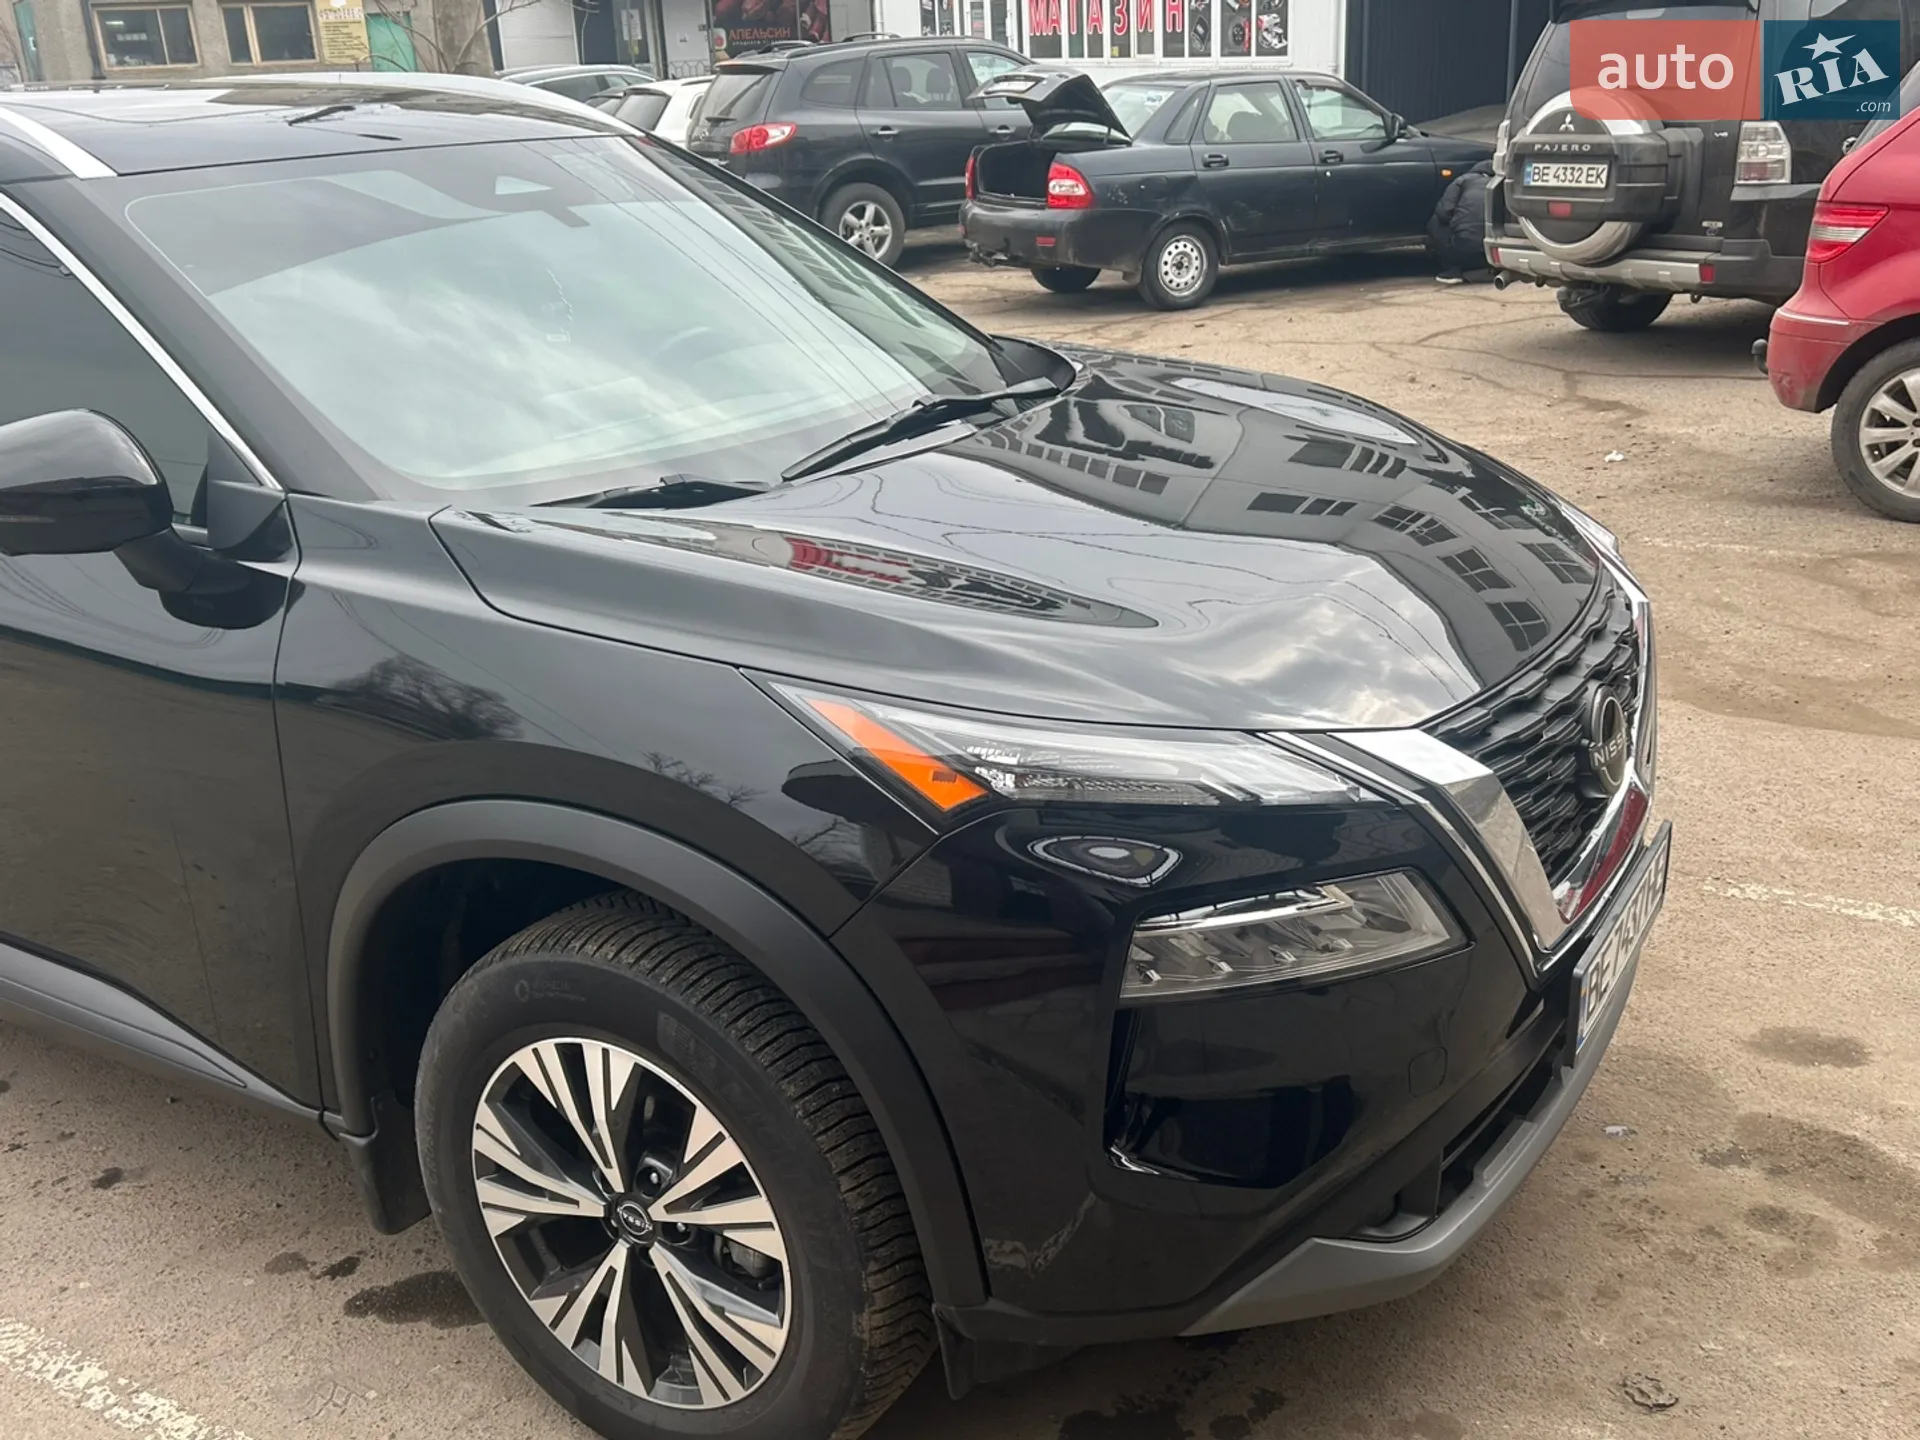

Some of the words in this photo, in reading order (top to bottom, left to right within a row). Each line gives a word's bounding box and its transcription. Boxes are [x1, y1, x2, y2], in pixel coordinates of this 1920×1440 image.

[729, 27, 791, 40] АПЕЛЬСИН
[1532, 166, 1549, 183] BE
[1554, 166, 1584, 184] 4332
[1585, 167, 1606, 184] EK
